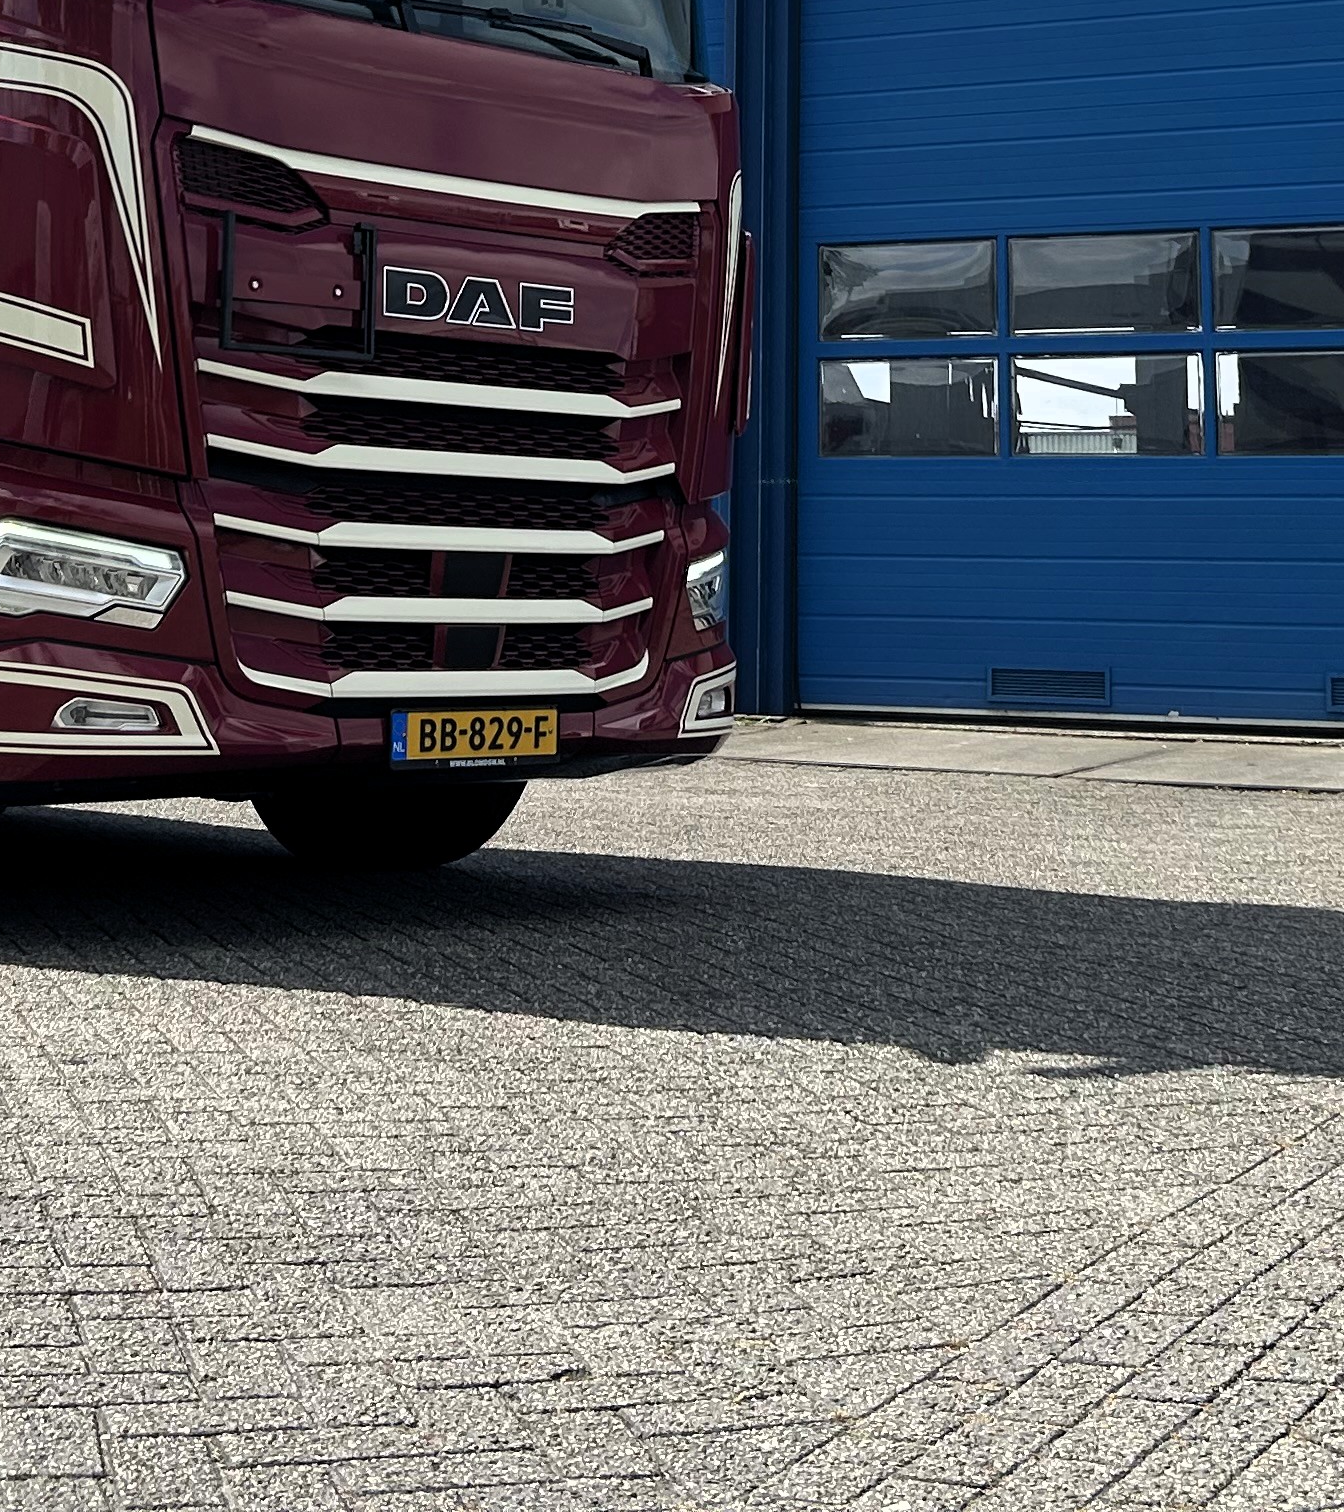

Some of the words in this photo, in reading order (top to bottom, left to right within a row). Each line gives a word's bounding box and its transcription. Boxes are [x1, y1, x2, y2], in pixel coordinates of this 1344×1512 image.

[383, 265, 575, 333] DAF
[392, 741, 406, 753] NL
[418, 715, 550, 753] BB-829-F
